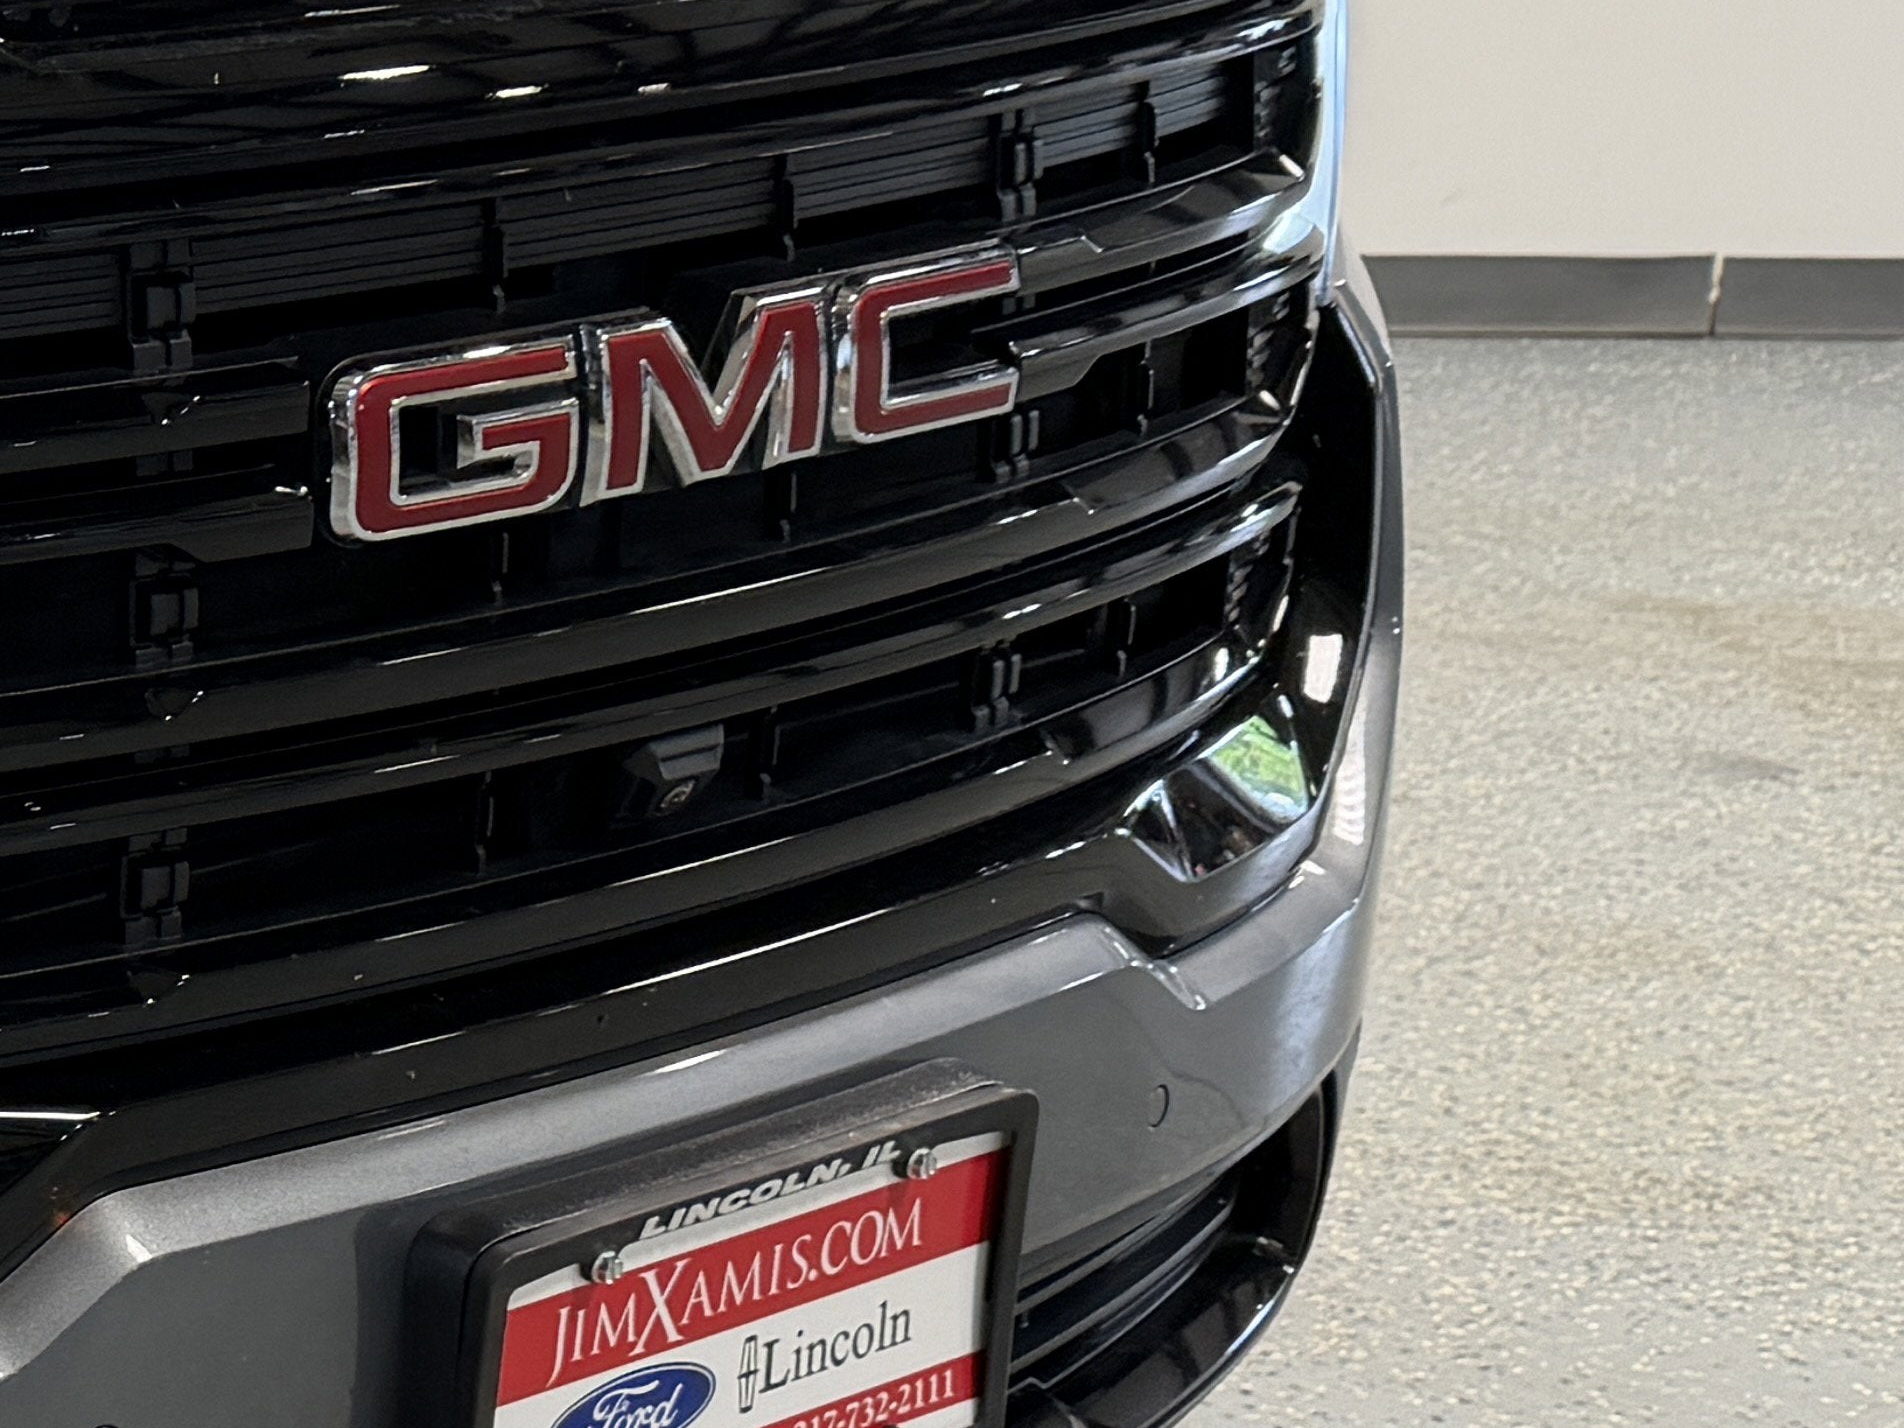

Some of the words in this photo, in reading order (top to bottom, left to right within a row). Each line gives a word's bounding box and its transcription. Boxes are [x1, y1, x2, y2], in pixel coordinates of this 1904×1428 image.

[328, 236, 1020, 542] GMC
[639, 1159, 852, 1240] LINCOLN,
[862, 1140, 901, 1170] IL
[546, 1197, 924, 1388] JIMXAMIS.COM
[758, 1300, 911, 1394] Lincoln
